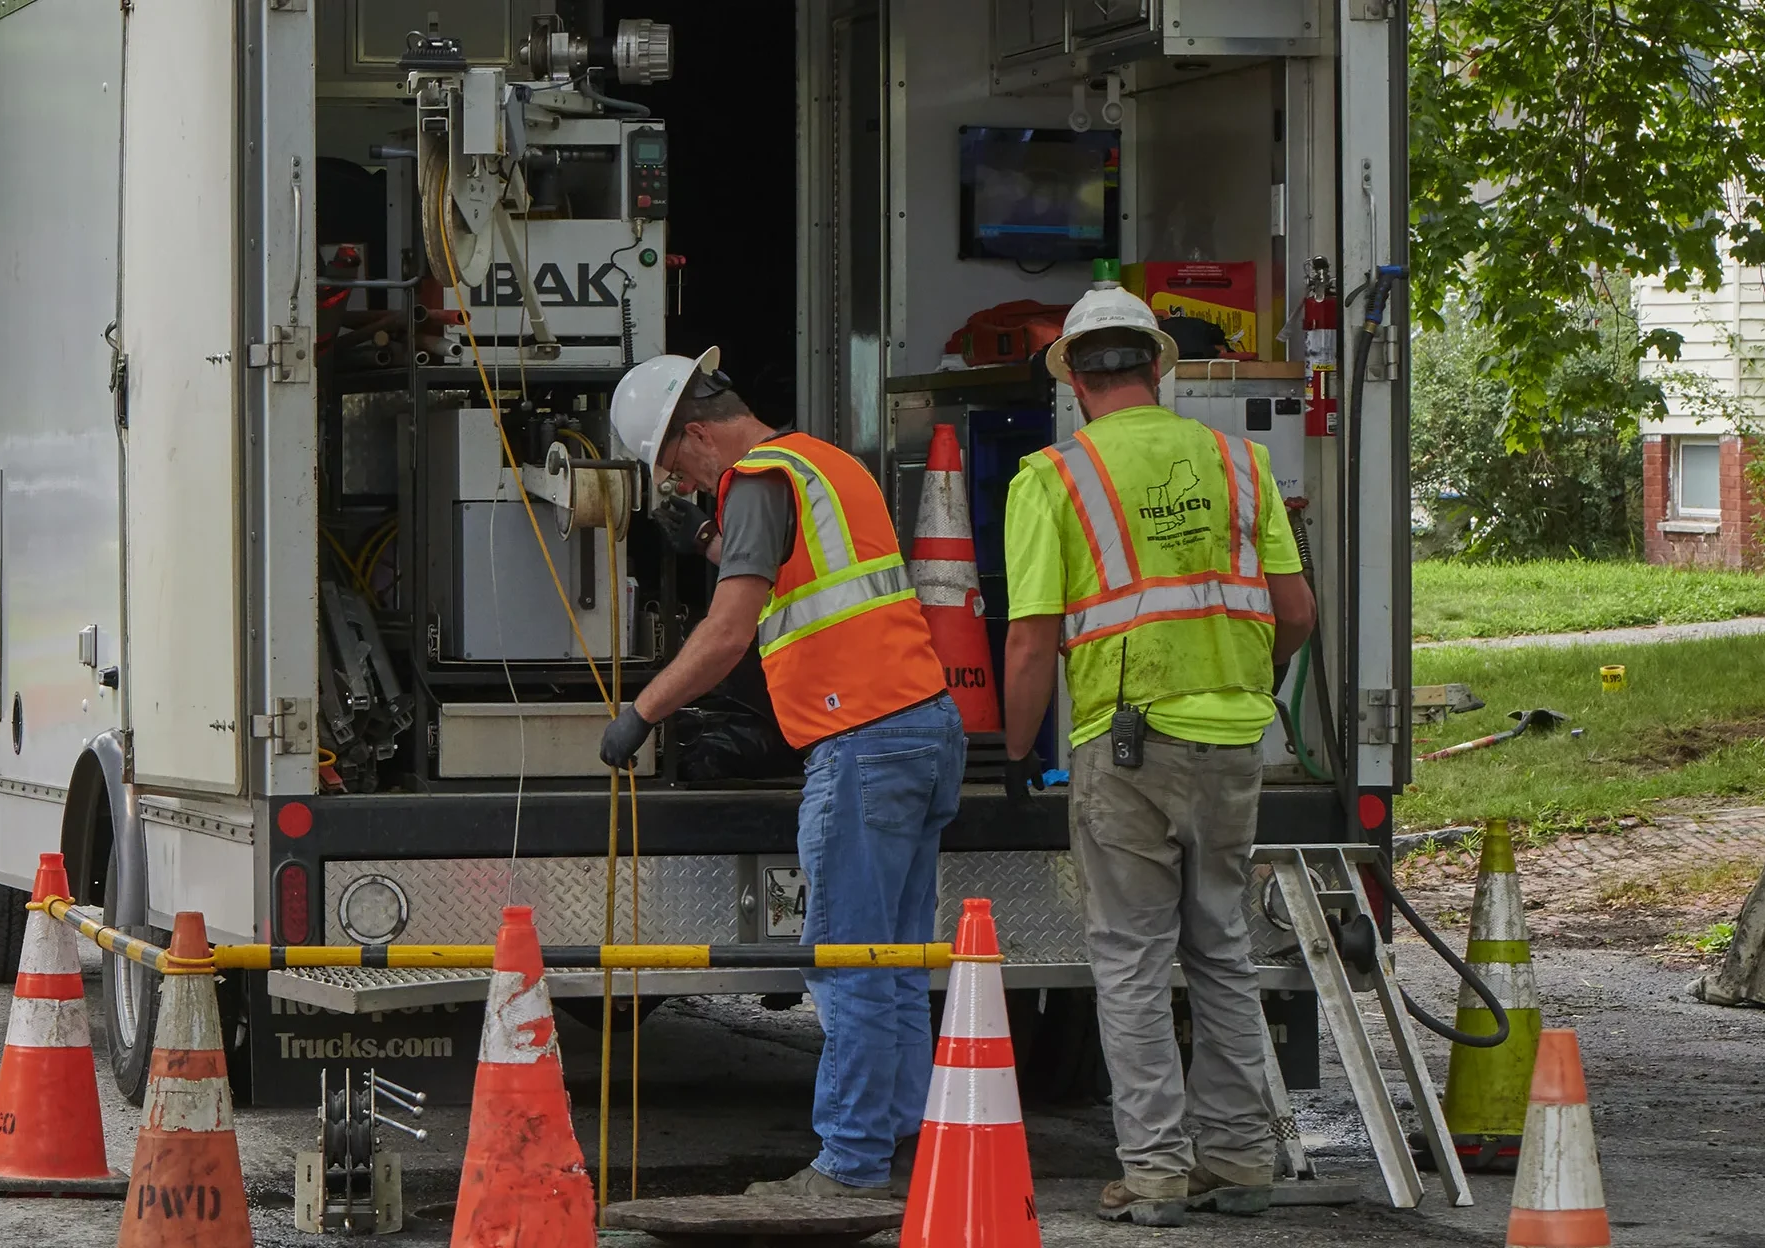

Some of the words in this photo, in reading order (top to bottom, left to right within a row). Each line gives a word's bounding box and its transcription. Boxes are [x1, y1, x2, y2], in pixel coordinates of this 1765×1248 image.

[1118, 742, 1129, 759] 3
[275, 1032, 453, 1059] Trucks.com
[137, 1184, 221, 1221] PWD
